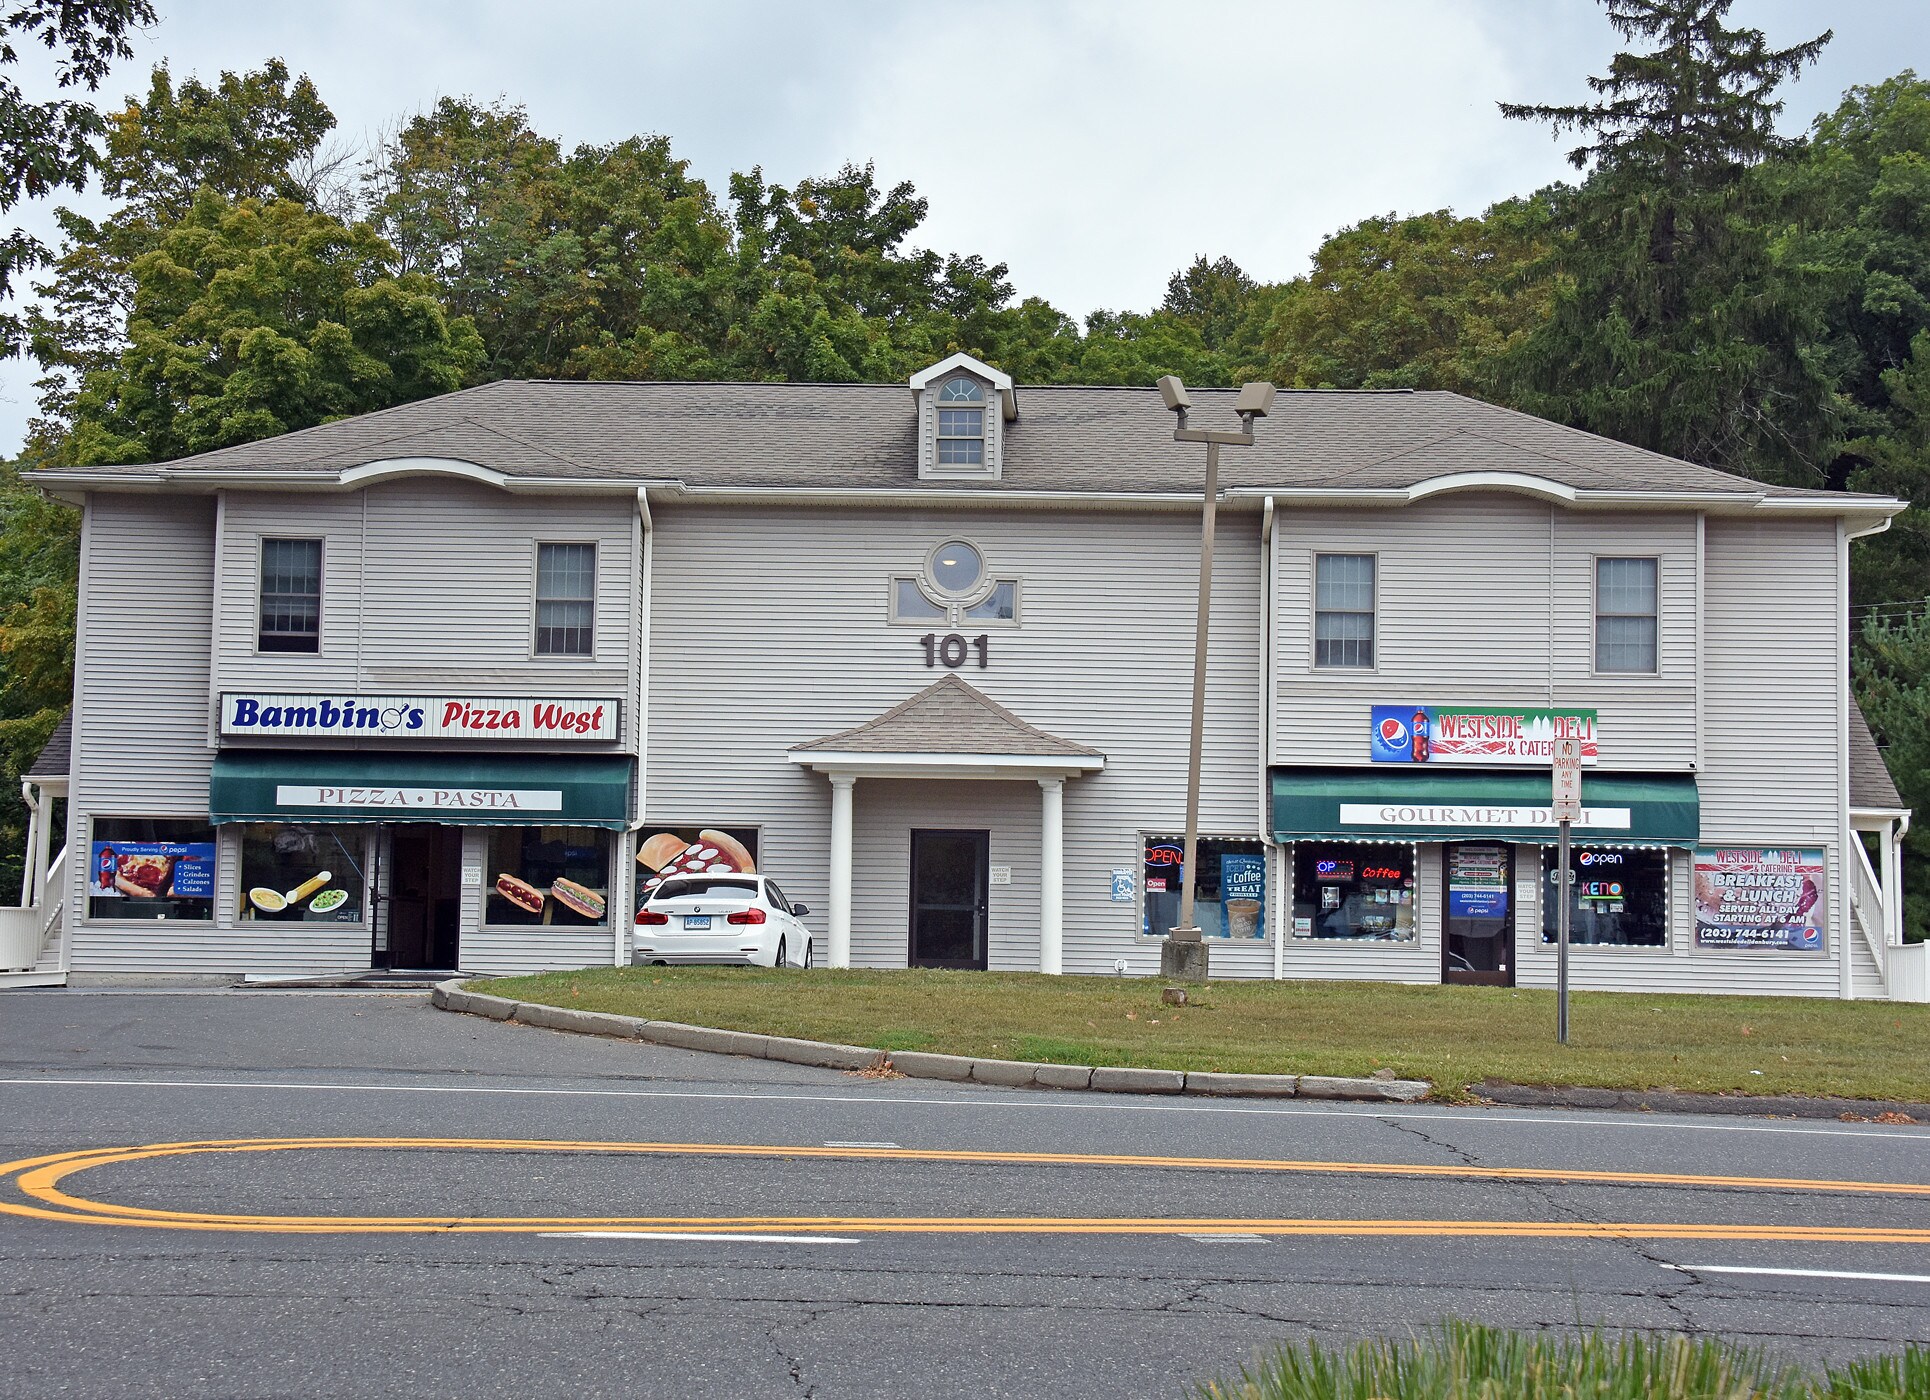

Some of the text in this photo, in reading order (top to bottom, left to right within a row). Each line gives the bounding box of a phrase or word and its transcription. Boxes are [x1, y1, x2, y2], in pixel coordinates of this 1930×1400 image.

[920, 633, 988, 668] 101
[232, 699, 604, 734] Bambino's Pizza West
[1439, 714, 1592, 740] WESTSIDE DELI
[1508, 740, 1553, 756] & CATER
[1562, 743, 1573, 755] NO
[1555, 757, 1579, 769] PARKING
[1561, 771, 1573, 779] ANY
[1561, 780, 1573, 788] TIME
[317, 788, 520, 808] PIZZA PASTA
[1379, 807, 1592, 825] GOURMET DI
[1145, 848, 1182, 864] OPEN
[1592, 854, 1623, 866] open
[1716, 850, 1802, 865] WESTSIDE DELI
[1226, 864, 1246, 873] ICED
[1362, 867, 1401, 879] Coffee
[1753, 864, 1793, 873] & CATERING
[1233, 870, 1261, 884] Coffee
[1714, 874, 1804, 888] BREAKFAST
[1147, 880, 1166, 888] Open
[1226, 884, 1261, 893] TREAT
[1582, 882, 1623, 896] KENO
[1723, 889, 1795, 903] & LUNCH
[1719, 905, 1800, 914] SERVED ALL DAY
[1713, 914, 1806, 924] STARTING AT 6 AM
[1700, 928, 1789, 939] (203) 744-6141
